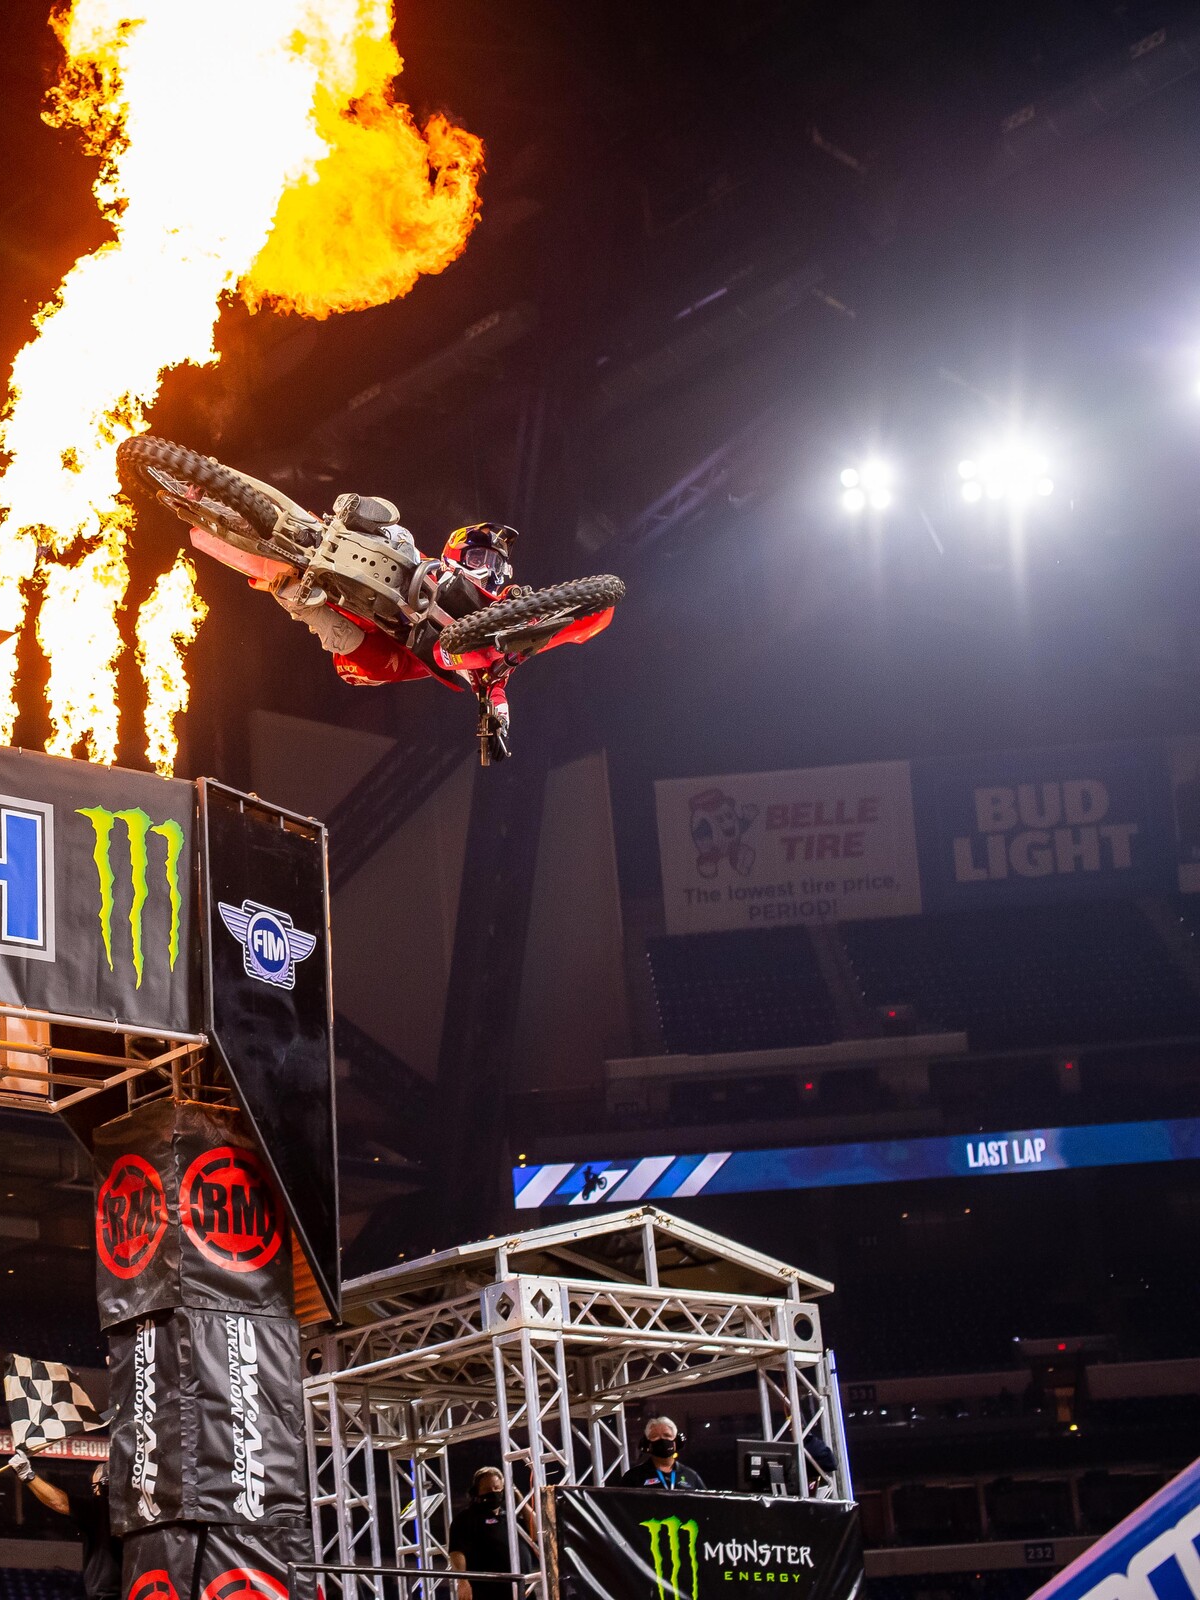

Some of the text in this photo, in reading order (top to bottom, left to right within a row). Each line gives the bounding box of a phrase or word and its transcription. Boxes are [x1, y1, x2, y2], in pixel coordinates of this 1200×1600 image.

[765, 798, 879, 832] BELLE
[974, 778, 1110, 833] BUD
[780, 830, 866, 862] TIRE
[953, 822, 1138, 882] LIGHT
[683, 887, 721, 904] The
[729, 880, 795, 901] lowest
[802, 876, 836, 895] tire
[748, 899, 838, 921] PERIOD!
[253, 929, 285, 962] FIM
[966, 1137, 1047, 1168] LAST LAP
[132, 1323, 146, 1490] ROCKY MOUNTAIN
[226, 1315, 246, 1488] ROCKY MOUNTAIN
[71, 1439, 110, 1457] GROU
[703, 1538, 815, 1569] MONSTER
[1027, 1546, 1053, 1560] 232
[724, 1570, 801, 1584] ENERGY
